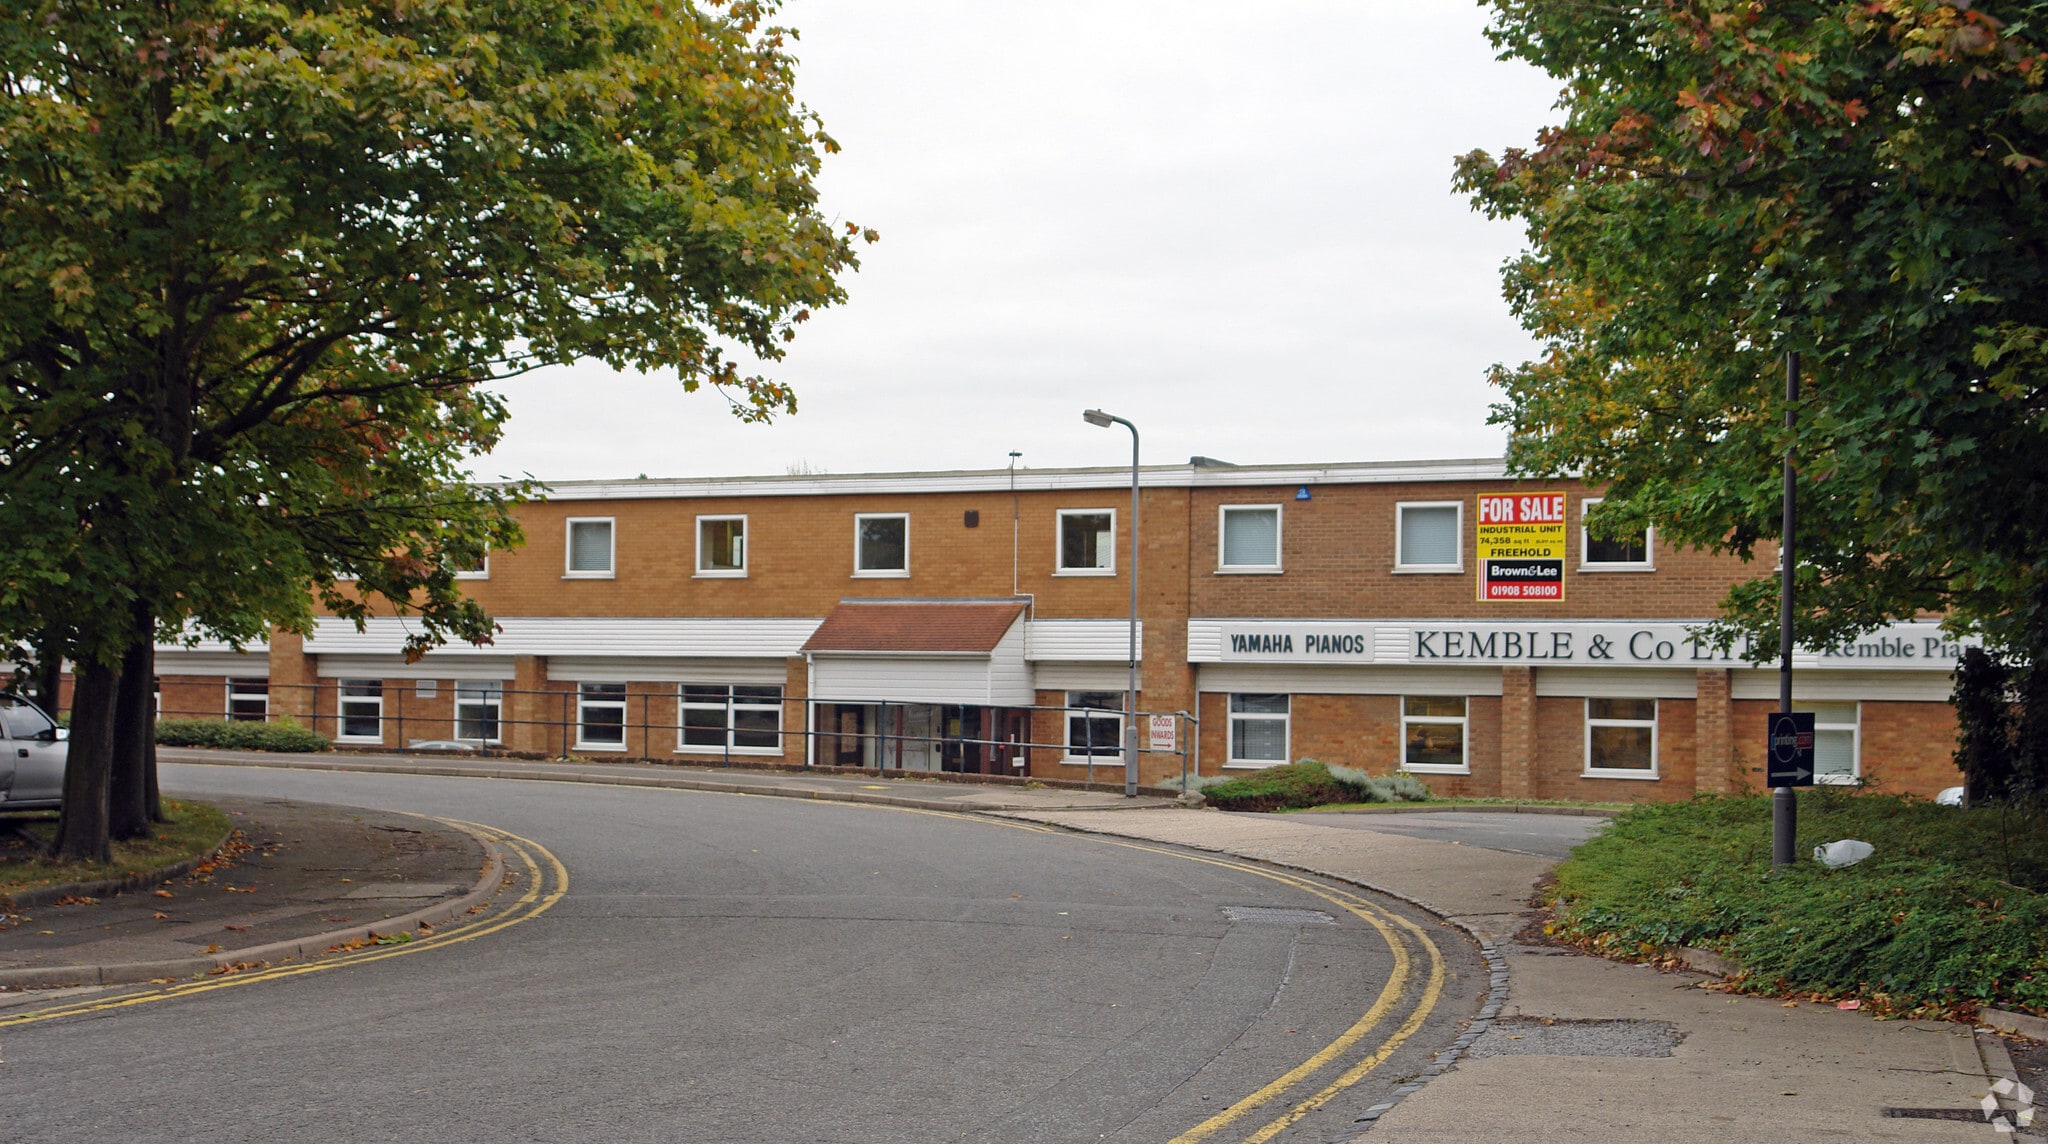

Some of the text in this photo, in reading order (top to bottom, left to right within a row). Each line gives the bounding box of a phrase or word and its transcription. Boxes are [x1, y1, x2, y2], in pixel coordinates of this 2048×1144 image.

[1480, 497, 1563, 522] FOR SALE
[1480, 525, 1562, 534] INDUSTRIAL UNIT
[1480, 537, 1511, 545] 74,358
[1490, 547, 1552, 557] FREEHOLD
[1491, 565, 1558, 576] Brown&Lee
[1491, 585, 1557, 596] 01908 508100
[1231, 634, 1364, 654] YAMAHA PIANOS
[1414, 630, 1574, 659] KEMBLE
[1588, 633, 1614, 659] &
[1629, 630, 1675, 660] Co
[1152, 717, 1172, 727] GOODS
[1151, 730, 1174, 740] INWARDS
